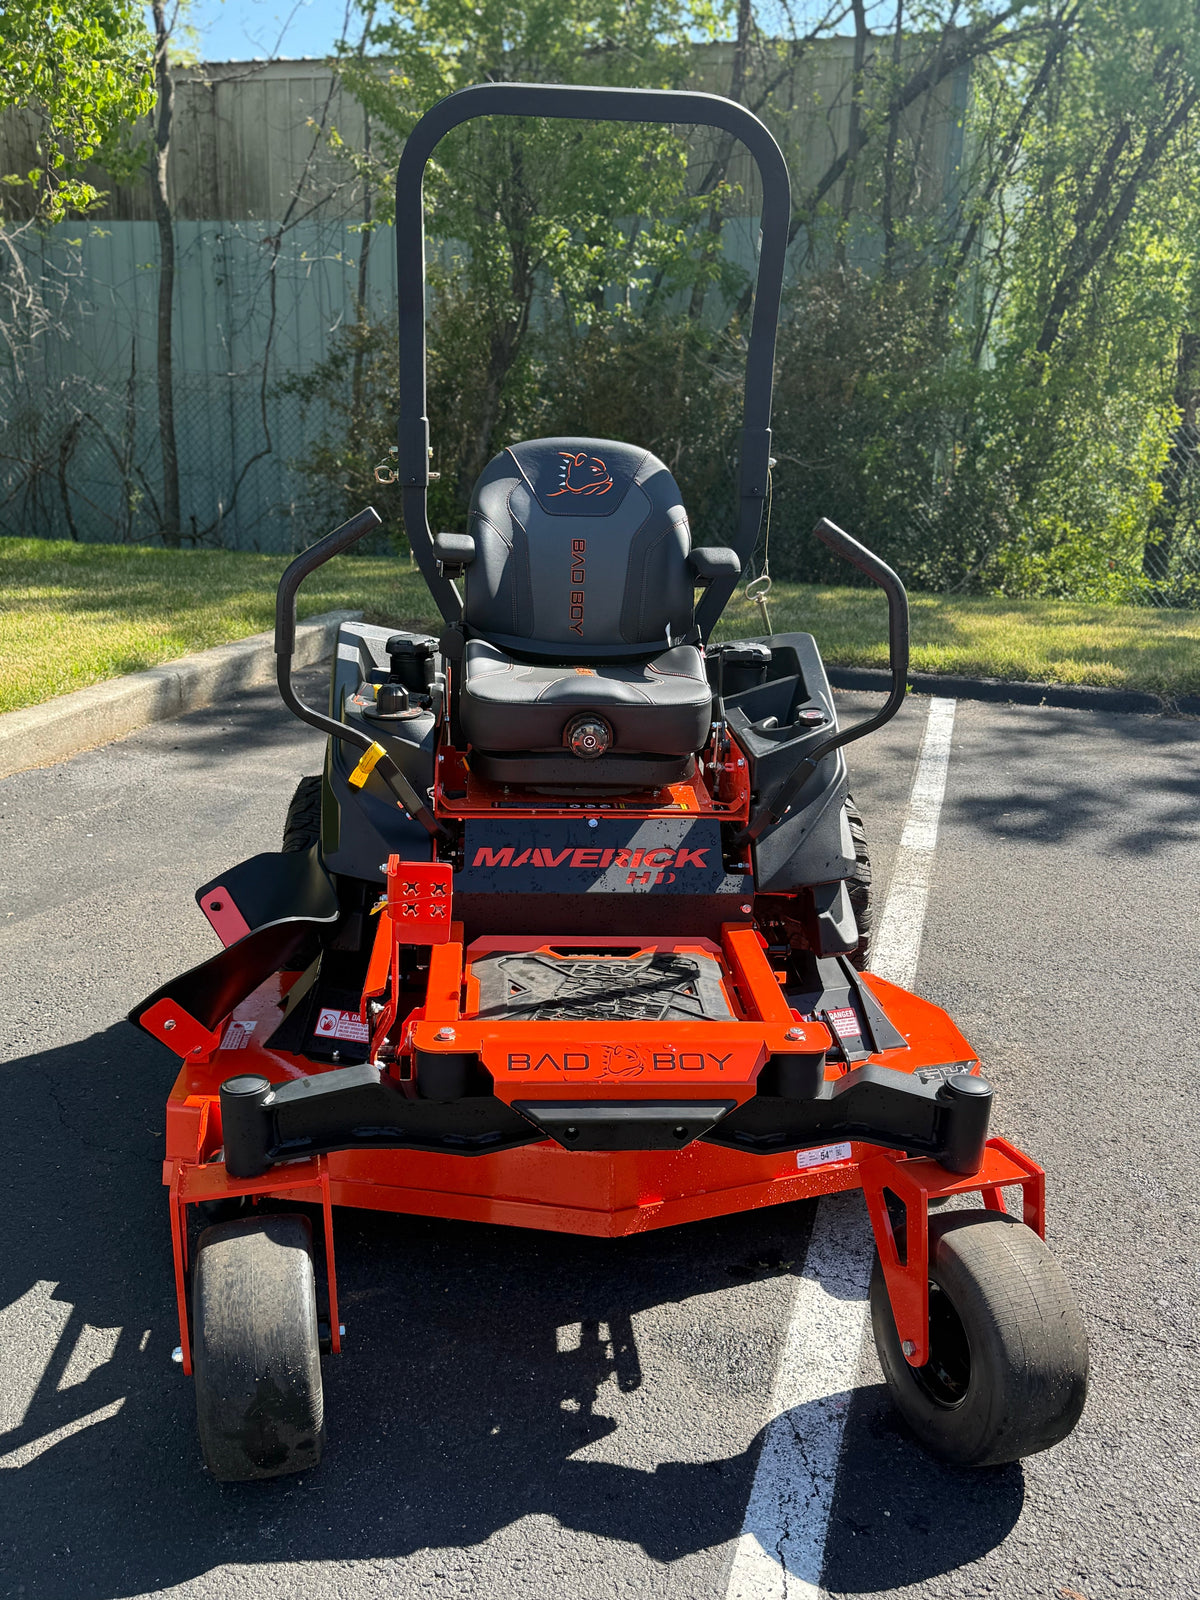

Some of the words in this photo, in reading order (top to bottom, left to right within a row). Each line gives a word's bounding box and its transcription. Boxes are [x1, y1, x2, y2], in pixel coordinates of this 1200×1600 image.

[570, 538, 586, 585] BAD
[568, 590, 585, 637] BOY
[472, 847, 711, 868] MAVERICK
[625, 871, 676, 885] HD
[829, 1010, 854, 1020] DANGER
[507, 1053, 590, 1071] BAD
[652, 1053, 734, 1071] BOY
